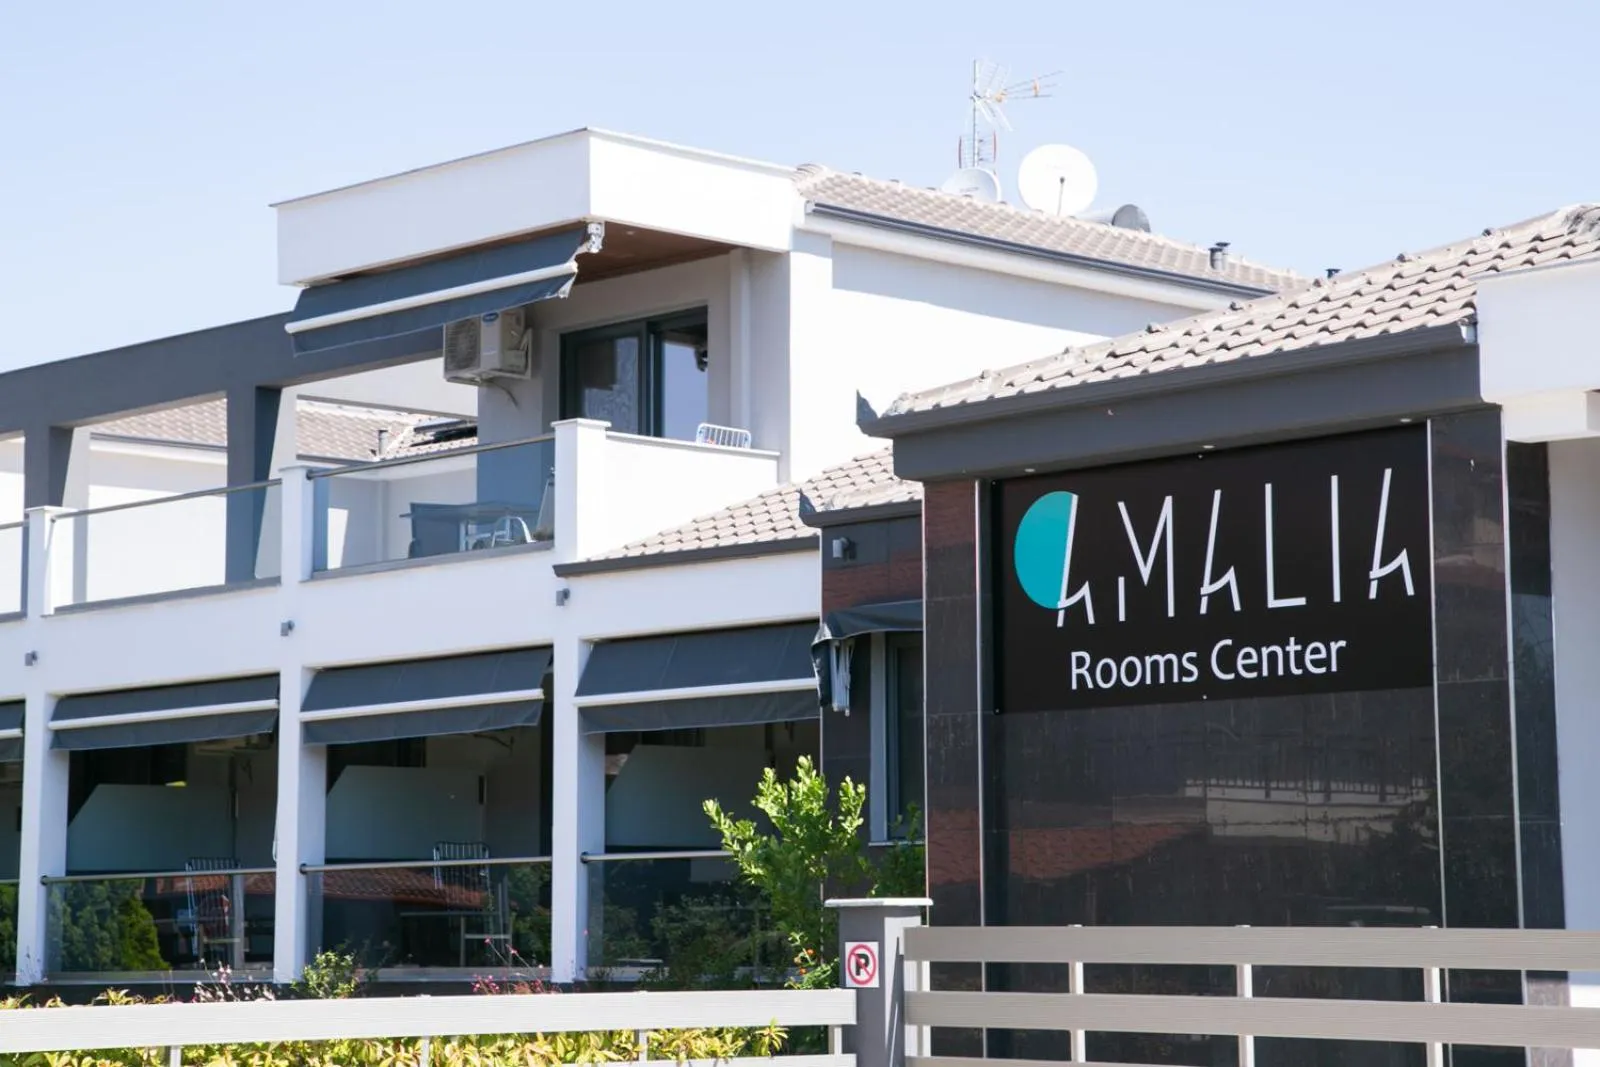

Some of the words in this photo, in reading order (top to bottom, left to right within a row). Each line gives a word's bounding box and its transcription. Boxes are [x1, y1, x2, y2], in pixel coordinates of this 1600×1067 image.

[1056, 468, 1415, 628] AMALIA
[1071, 650, 1199, 690] Rooms
[1210, 637, 1346, 680] Center
[855, 953, 870, 976] P
